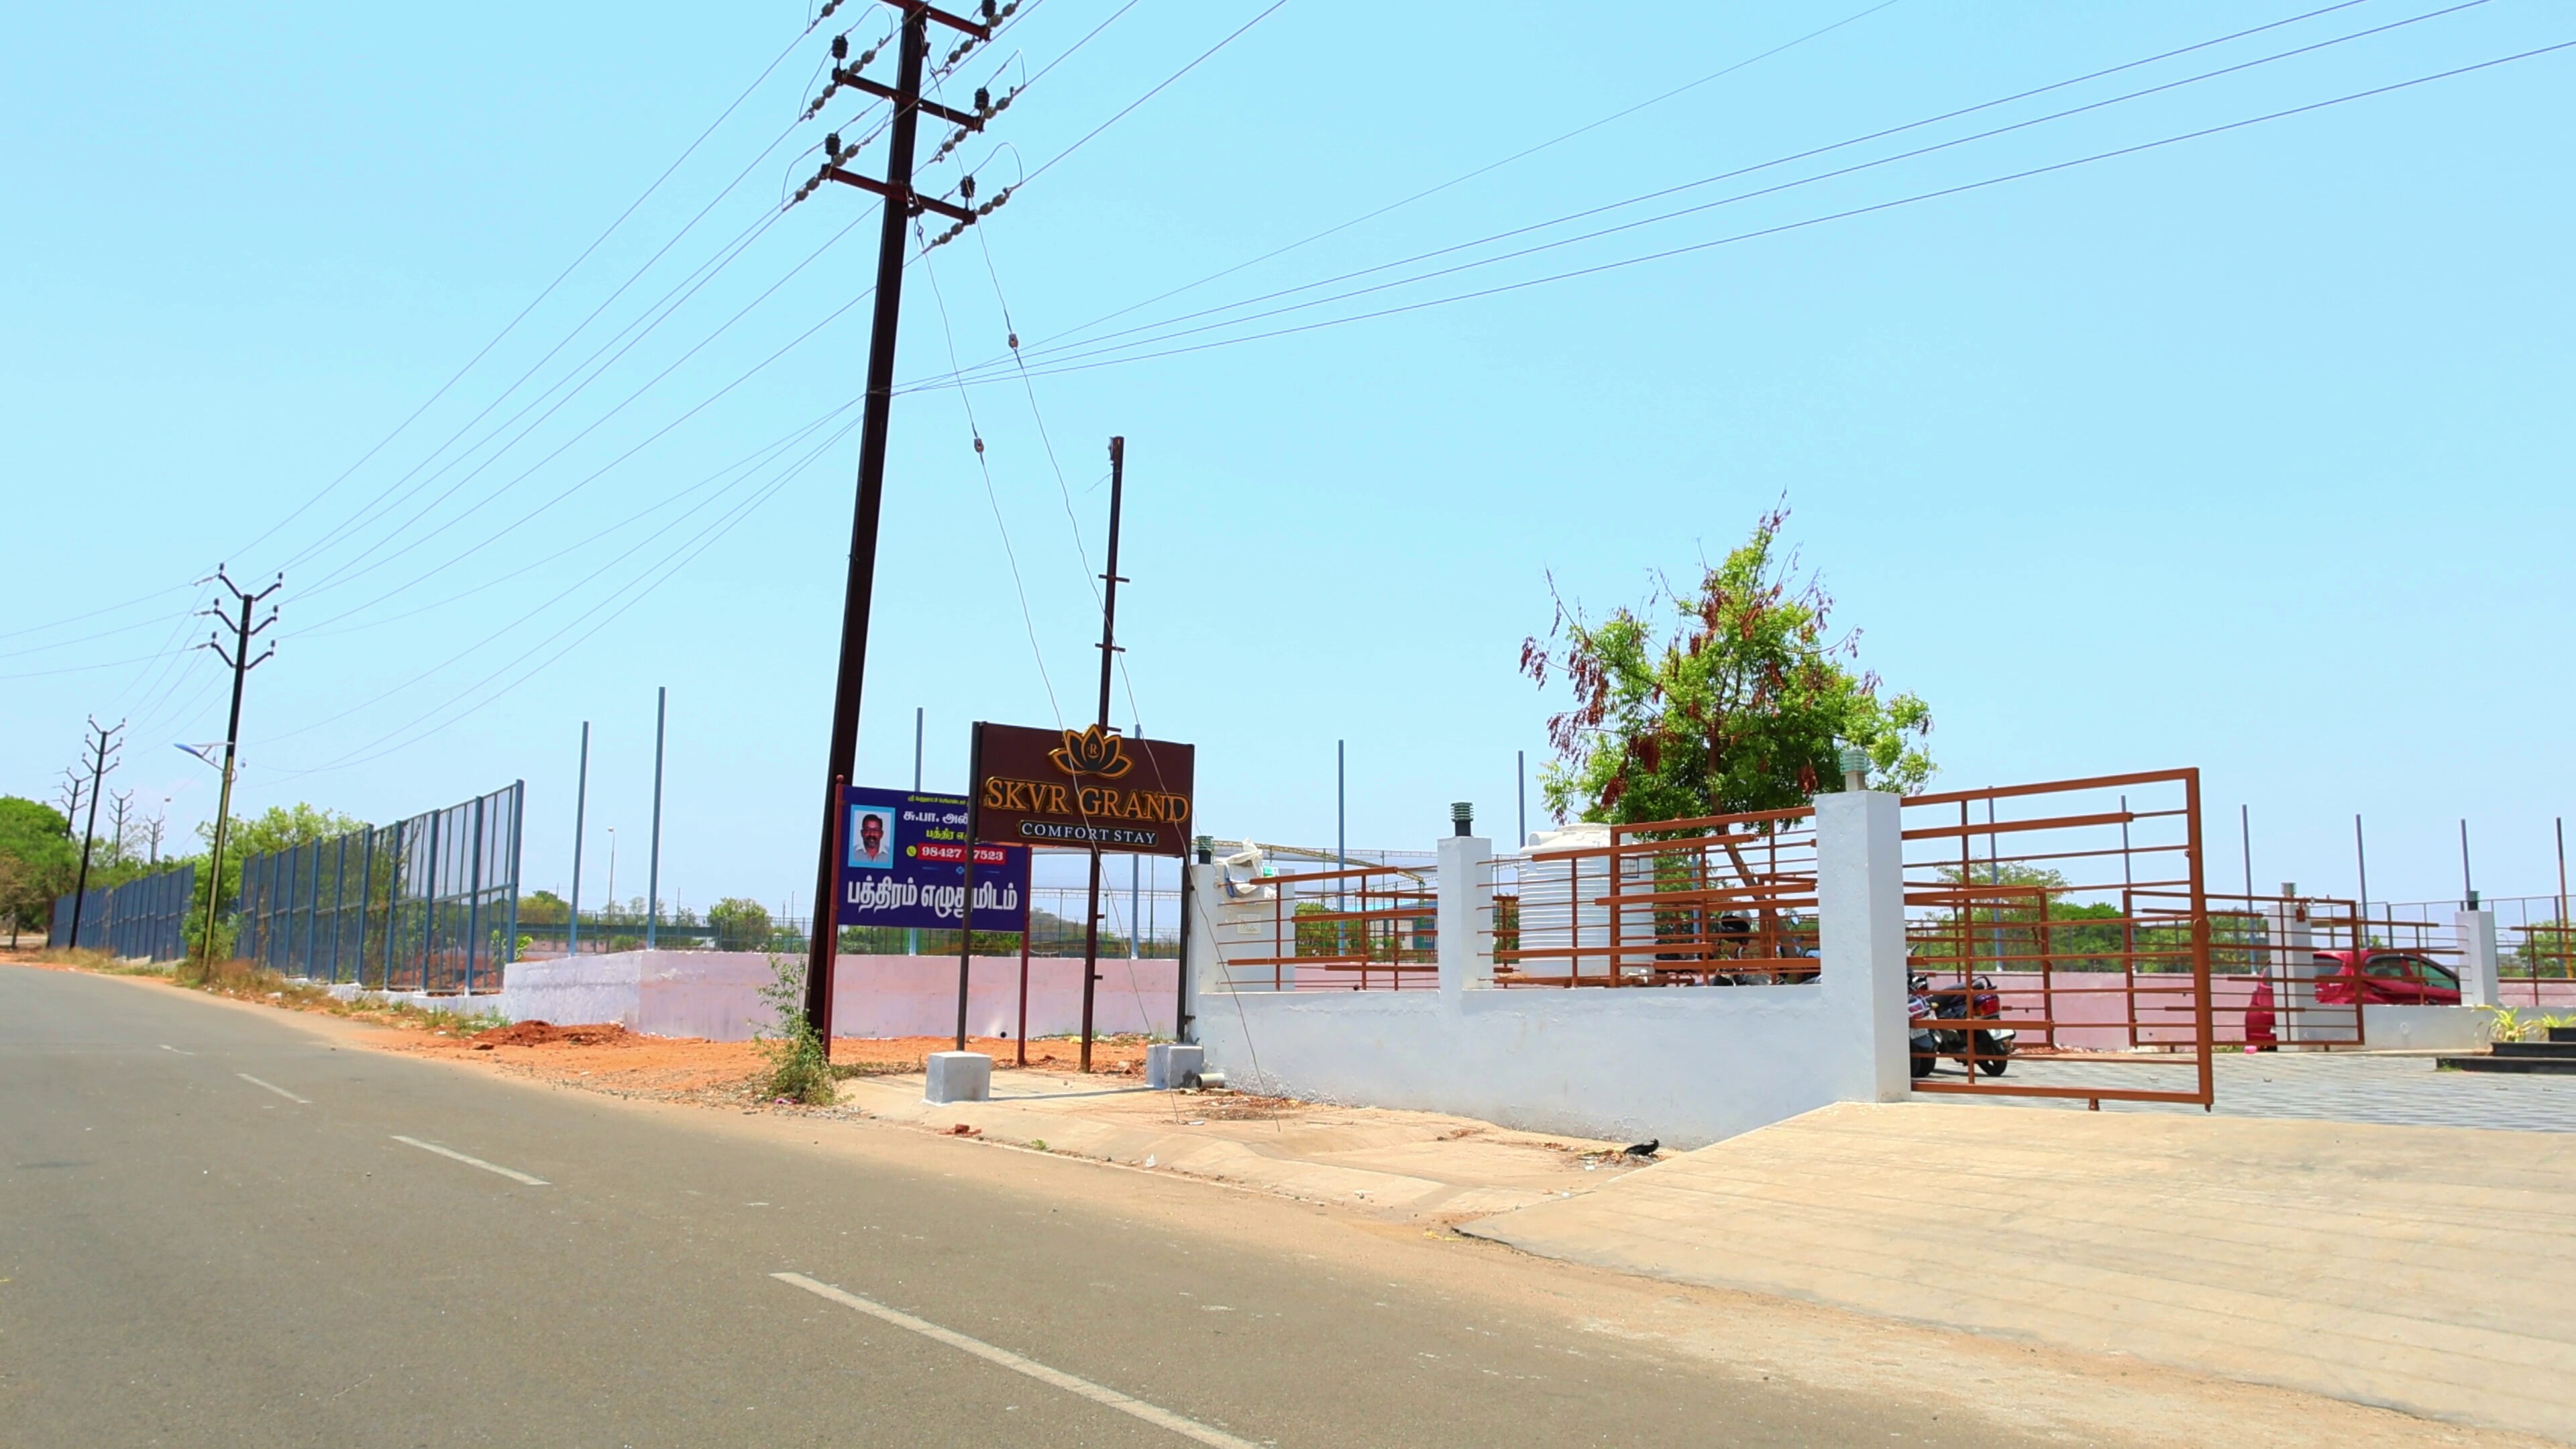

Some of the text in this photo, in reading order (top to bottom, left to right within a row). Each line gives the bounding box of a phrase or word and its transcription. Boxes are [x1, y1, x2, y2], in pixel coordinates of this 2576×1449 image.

[987, 779, 1191, 822] SKVR GRAND
[1022, 822, 1156, 845] COMFORT STAY
[922, 847, 1004, 861] 98427 7523
[847, 875, 918, 913] பத்திரம்
